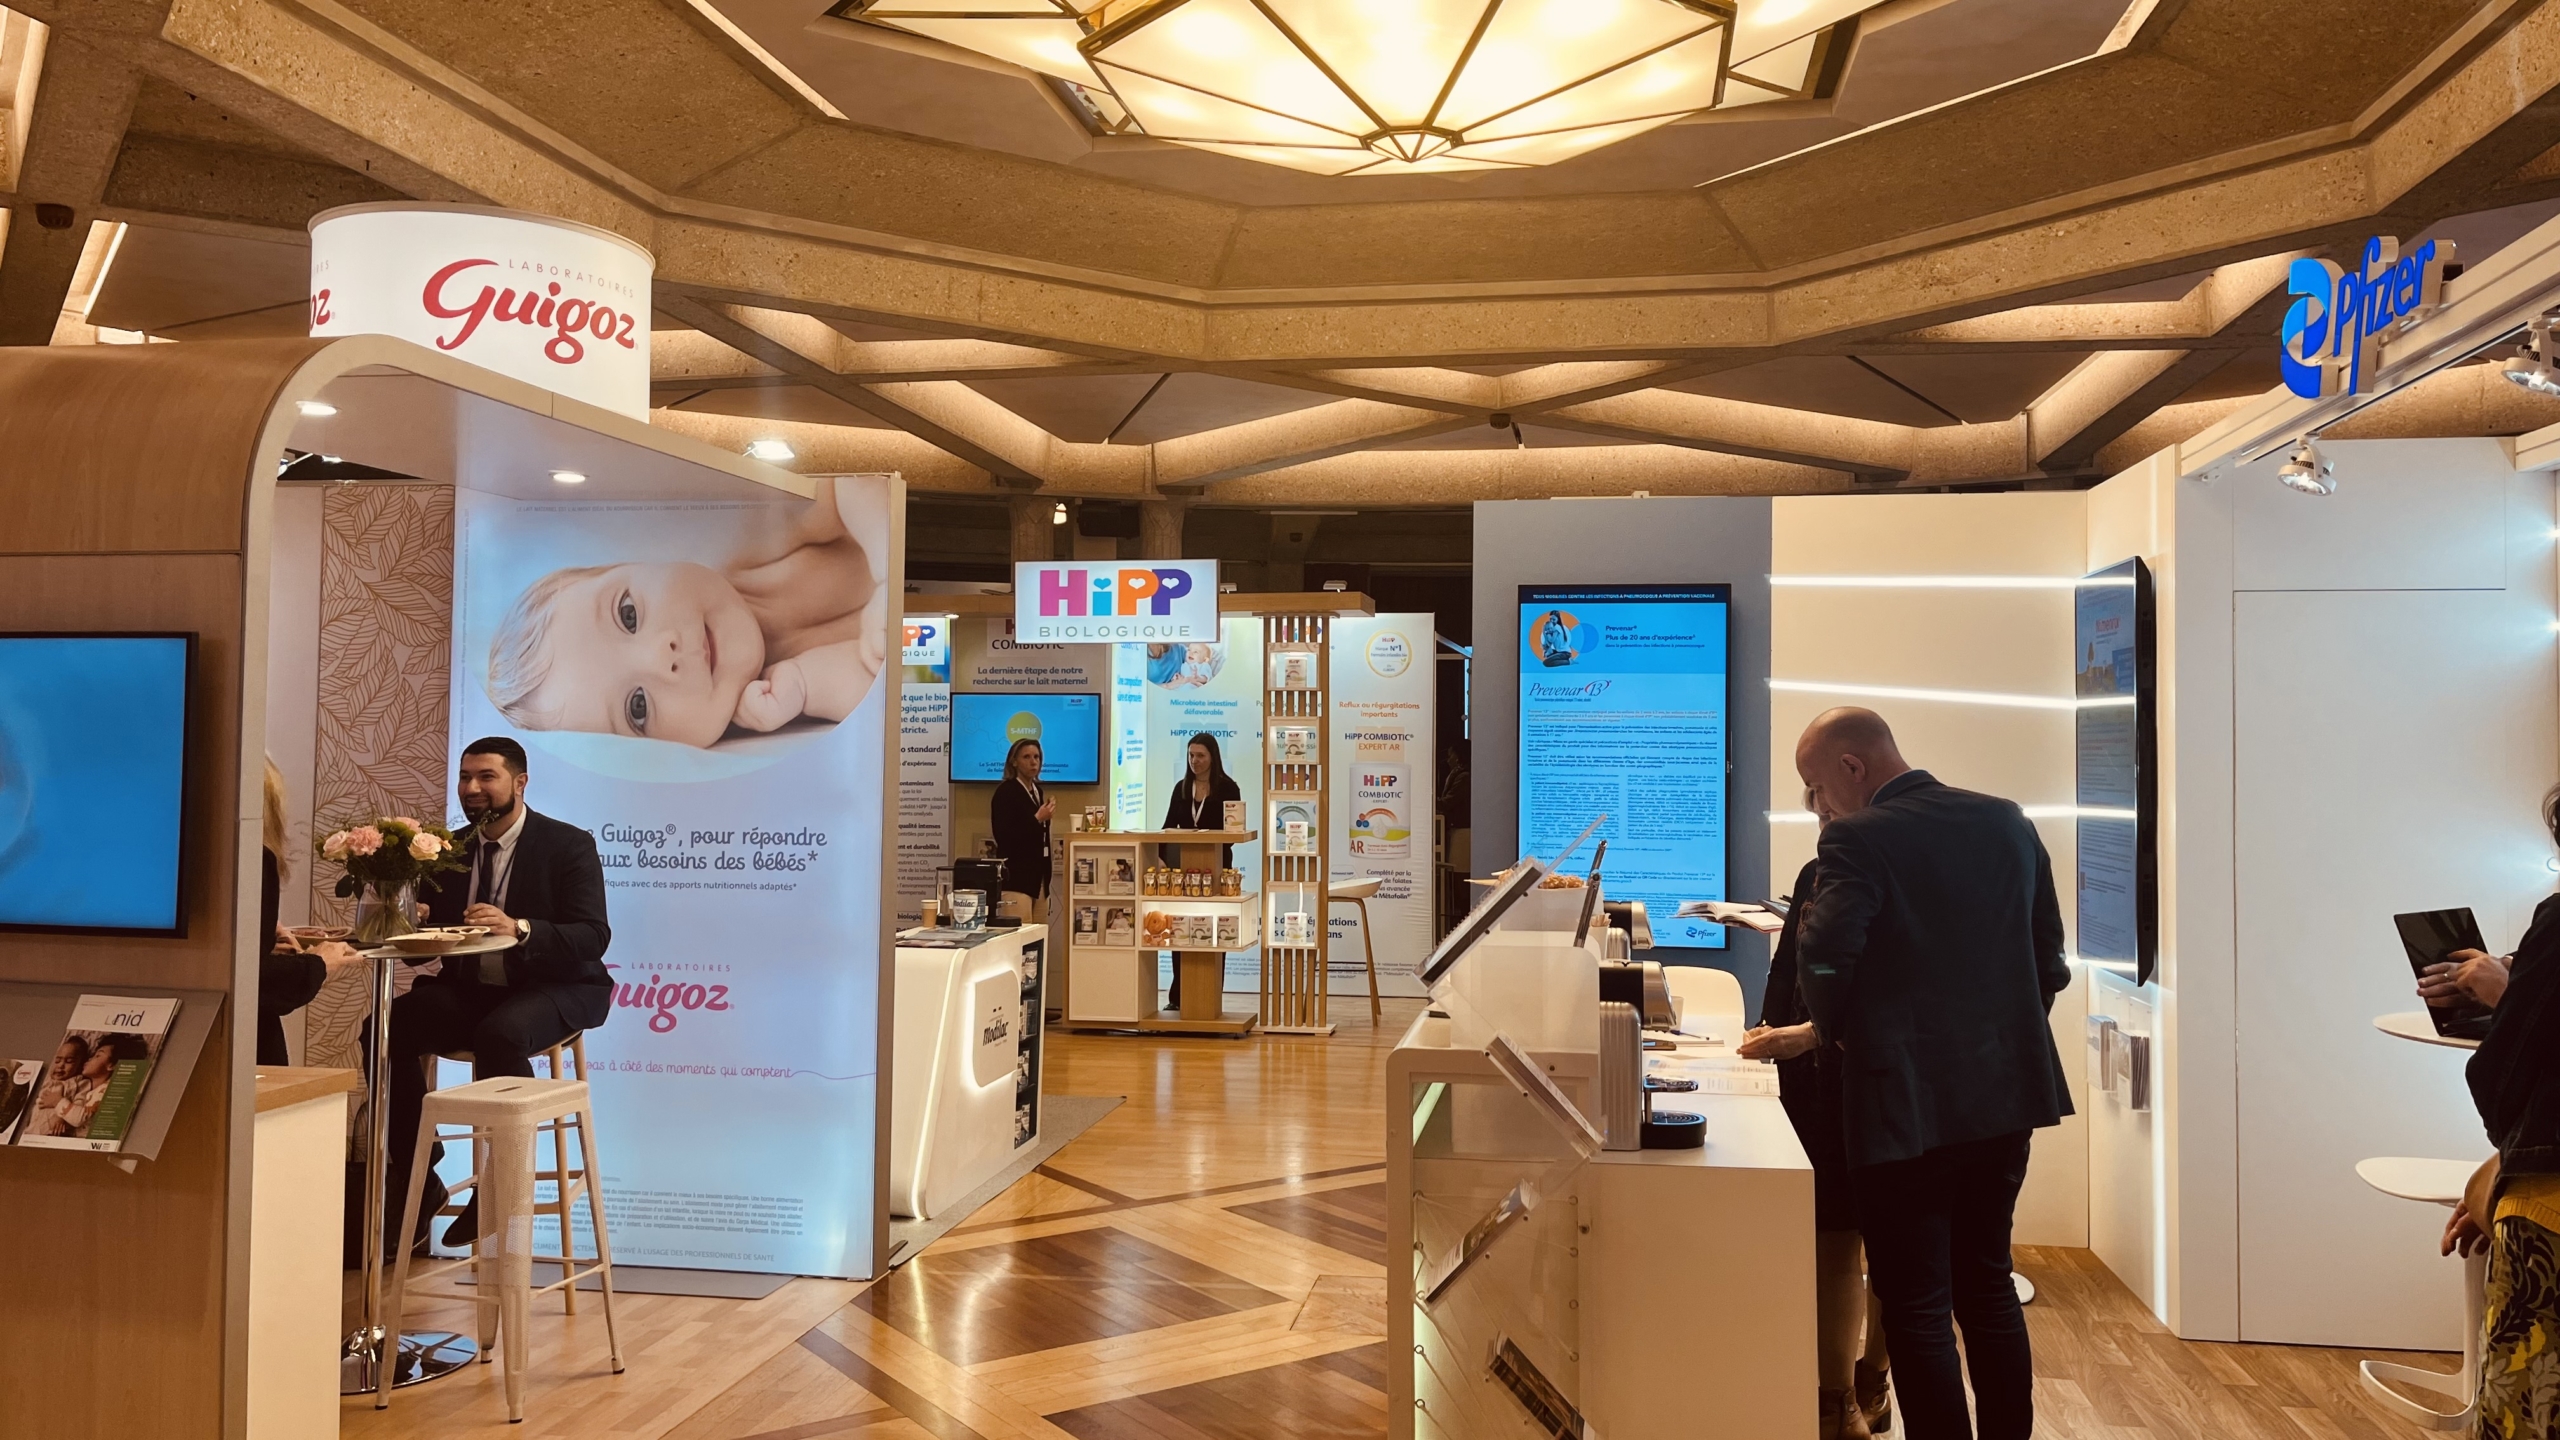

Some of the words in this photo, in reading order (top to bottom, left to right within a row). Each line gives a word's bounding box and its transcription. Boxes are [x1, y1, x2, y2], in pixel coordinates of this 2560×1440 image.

[509, 258, 633, 299] LABORATOIRES
[422, 258, 635, 364] Guigoz
[2333, 235, 2436, 396] Pfizer
[1039, 568, 1192, 617] HiPP
[1039, 625, 1191, 638] BIOLOGIQUE
[989, 666, 1023, 674] dernière
[1024, 666, 1048, 676] étape
[973, 677, 1012, 685] recherche
[1028, 677, 1035, 685] le
[1036, 677, 1049, 685] lait
[1051, 677, 1088, 685] maternel
[1528, 682, 1584, 696] Prevenar
[909, 695, 923, 703] que
[925, 693, 933, 701] le
[934, 693, 949, 702] bio,
[1170, 699, 1206, 707] Microbiote
[1207, 699, 1238, 707] intestinal
[901, 704, 927, 714] ogique
[928, 704, 948, 712] HiPP
[1371, 701, 1420, 711] régurgitations
[1184, 708, 1224, 716] défavorable
[921, 715, 949, 725] qualité
[901, 726, 928, 734] stricte.
[1171, 729, 1188, 737] HiPP
[907, 745, 941, 753] standard
[1389, 743, 1400, 751] AR
[1364, 775, 1397, 786] HiPP
[690, 829, 733, 848] pour
[742, 826, 827, 849] répondre
[1350, 840, 1364, 854] AR
[637, 849, 707, 870] besoins
[714, 851, 746, 871] des
[605, 878, 629, 889] fiques
[631, 880, 650, 888] avec
[652, 879, 667, 889] des
[669, 880, 702, 891] apports
[703, 880, 758, 890] nutritionnels
[1698, 927, 1716, 939] Pfizer
[631, 962, 731, 973] LABORATOIRES
[609, 1060, 617, 1071] à
[620, 1061, 643, 1072] côté
[646, 1061, 663, 1073] des
[666, 1064, 716, 1075] moments
[720, 1065, 738, 1078] qui
[741, 1066, 793, 1079] comptent
